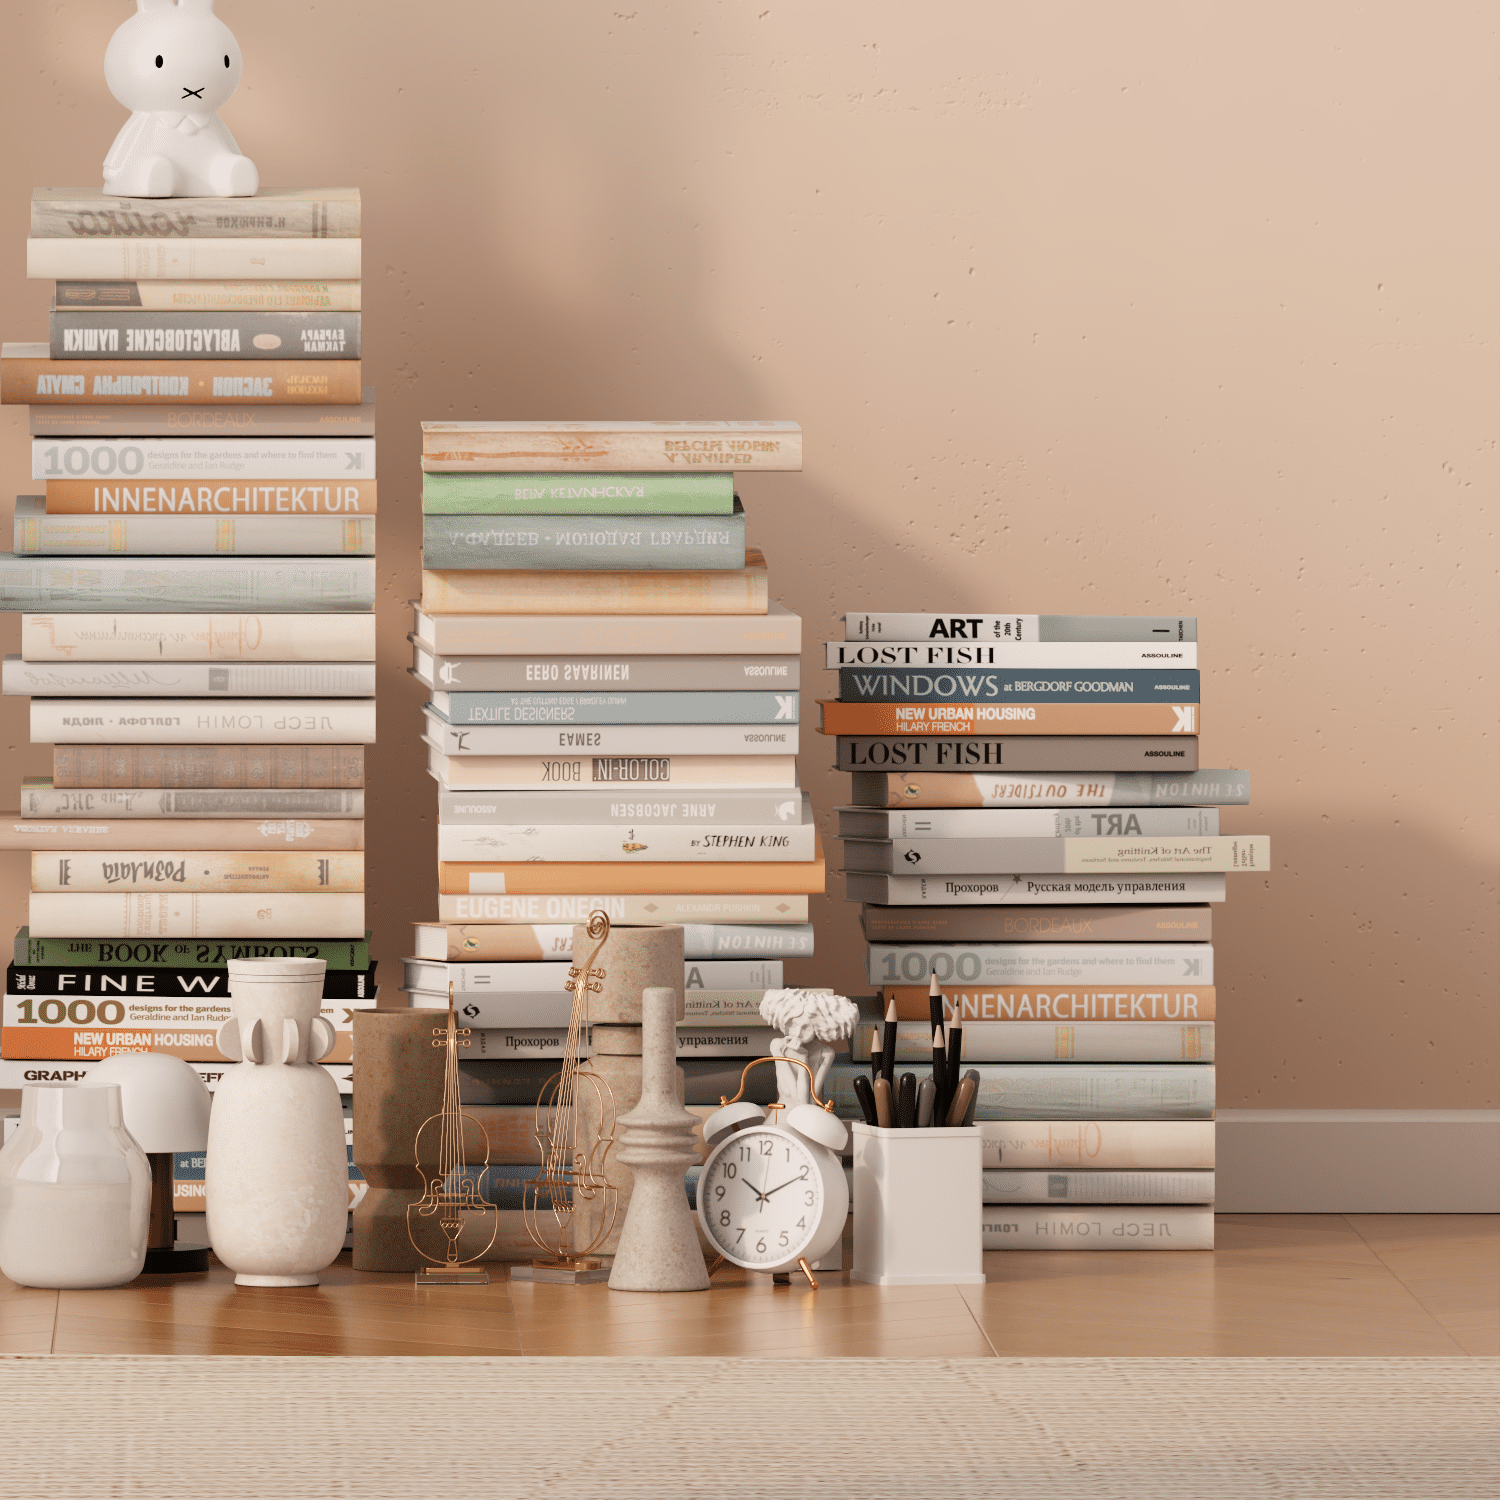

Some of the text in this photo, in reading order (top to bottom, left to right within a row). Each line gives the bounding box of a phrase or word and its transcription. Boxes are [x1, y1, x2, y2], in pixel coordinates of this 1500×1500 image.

[167, 412, 256, 428] BORDEAUX
[319, 416, 362, 424] ASSOULINE
[44, 446, 144, 475] 1000
[148, 451, 337, 461] designs for the gardens and where to find them
[148, 461, 245, 472] Geraldine and Ian Rudge
[93, 486, 359, 512] INNENARCHITEKTUR
[929, 618, 983, 638] ART
[993, 620, 1001, 631] the
[1015, 618, 1023, 640] Century
[837, 646, 996, 664] LOST FISH
[852, 674, 1134, 697] WINDOWS at BERGDORF GOODMAN
[896, 707, 1036, 720] NEW URBAN HOUSING
[896, 721, 970, 731] HILARY FRENCH
[849, 742, 1004, 765] LOST FISH
[541, 761, 581, 782] BOOK
[991, 784, 1105, 800] THE OUTSIDERS
[1155, 782, 1220, 797] HINTON
[454, 805, 496, 814] ASSOULINE
[610, 803, 715, 817] ARNE JACOBSEN
[702, 835, 790, 848] STEPHEN KING
[945, 881, 1185, 895] Прохоров Русская модель управления
[456, 897, 625, 919] EUGENE ONEGIN
[676, 903, 761, 912] ALEXANDR PUSHKIN
[1004, 917, 1093, 933] BORDEAUX
[1155, 921, 1199, 929] ASSOULINE
[718, 935, 784, 950] HINTON
[881, 952, 981, 982] 1000
[984, 956, 1175, 967] designs for the gardens and where to find them
[986, 967, 1083, 978] Geraldine and Ian Rudge
[58, 974, 155, 992] FINE
[357, 974, 365, 998] ASSOULINE
[16, 999, 125, 1025] 1000
[129, 1004, 163, 1013] designs
[195, 1005, 231, 1013] gardens
[172, 1013, 188, 1021] and
[191, 1013, 204, 1021] Ian
[74, 1032, 213, 1047] NEW URBAN HOUSING
[505, 1034, 749, 1050] Прохоров управления
[74, 1046, 107, 1056] HILARY
[739, 1146, 750, 1162] 11
[759, 1140, 773, 1156] 12
[722, 1162, 737, 1179] 10
[799, 1165, 809, 1181] 2
[715, 1185, 726, 1202] 9
[804, 1190, 814, 1206] 3
[720, 1210, 731, 1227] 8
[796, 1215, 806, 1230] 4
[736, 1228, 746, 1244] 7
[778, 1231, 789, 1247] 5
[756, 1237, 767, 1253] 6
